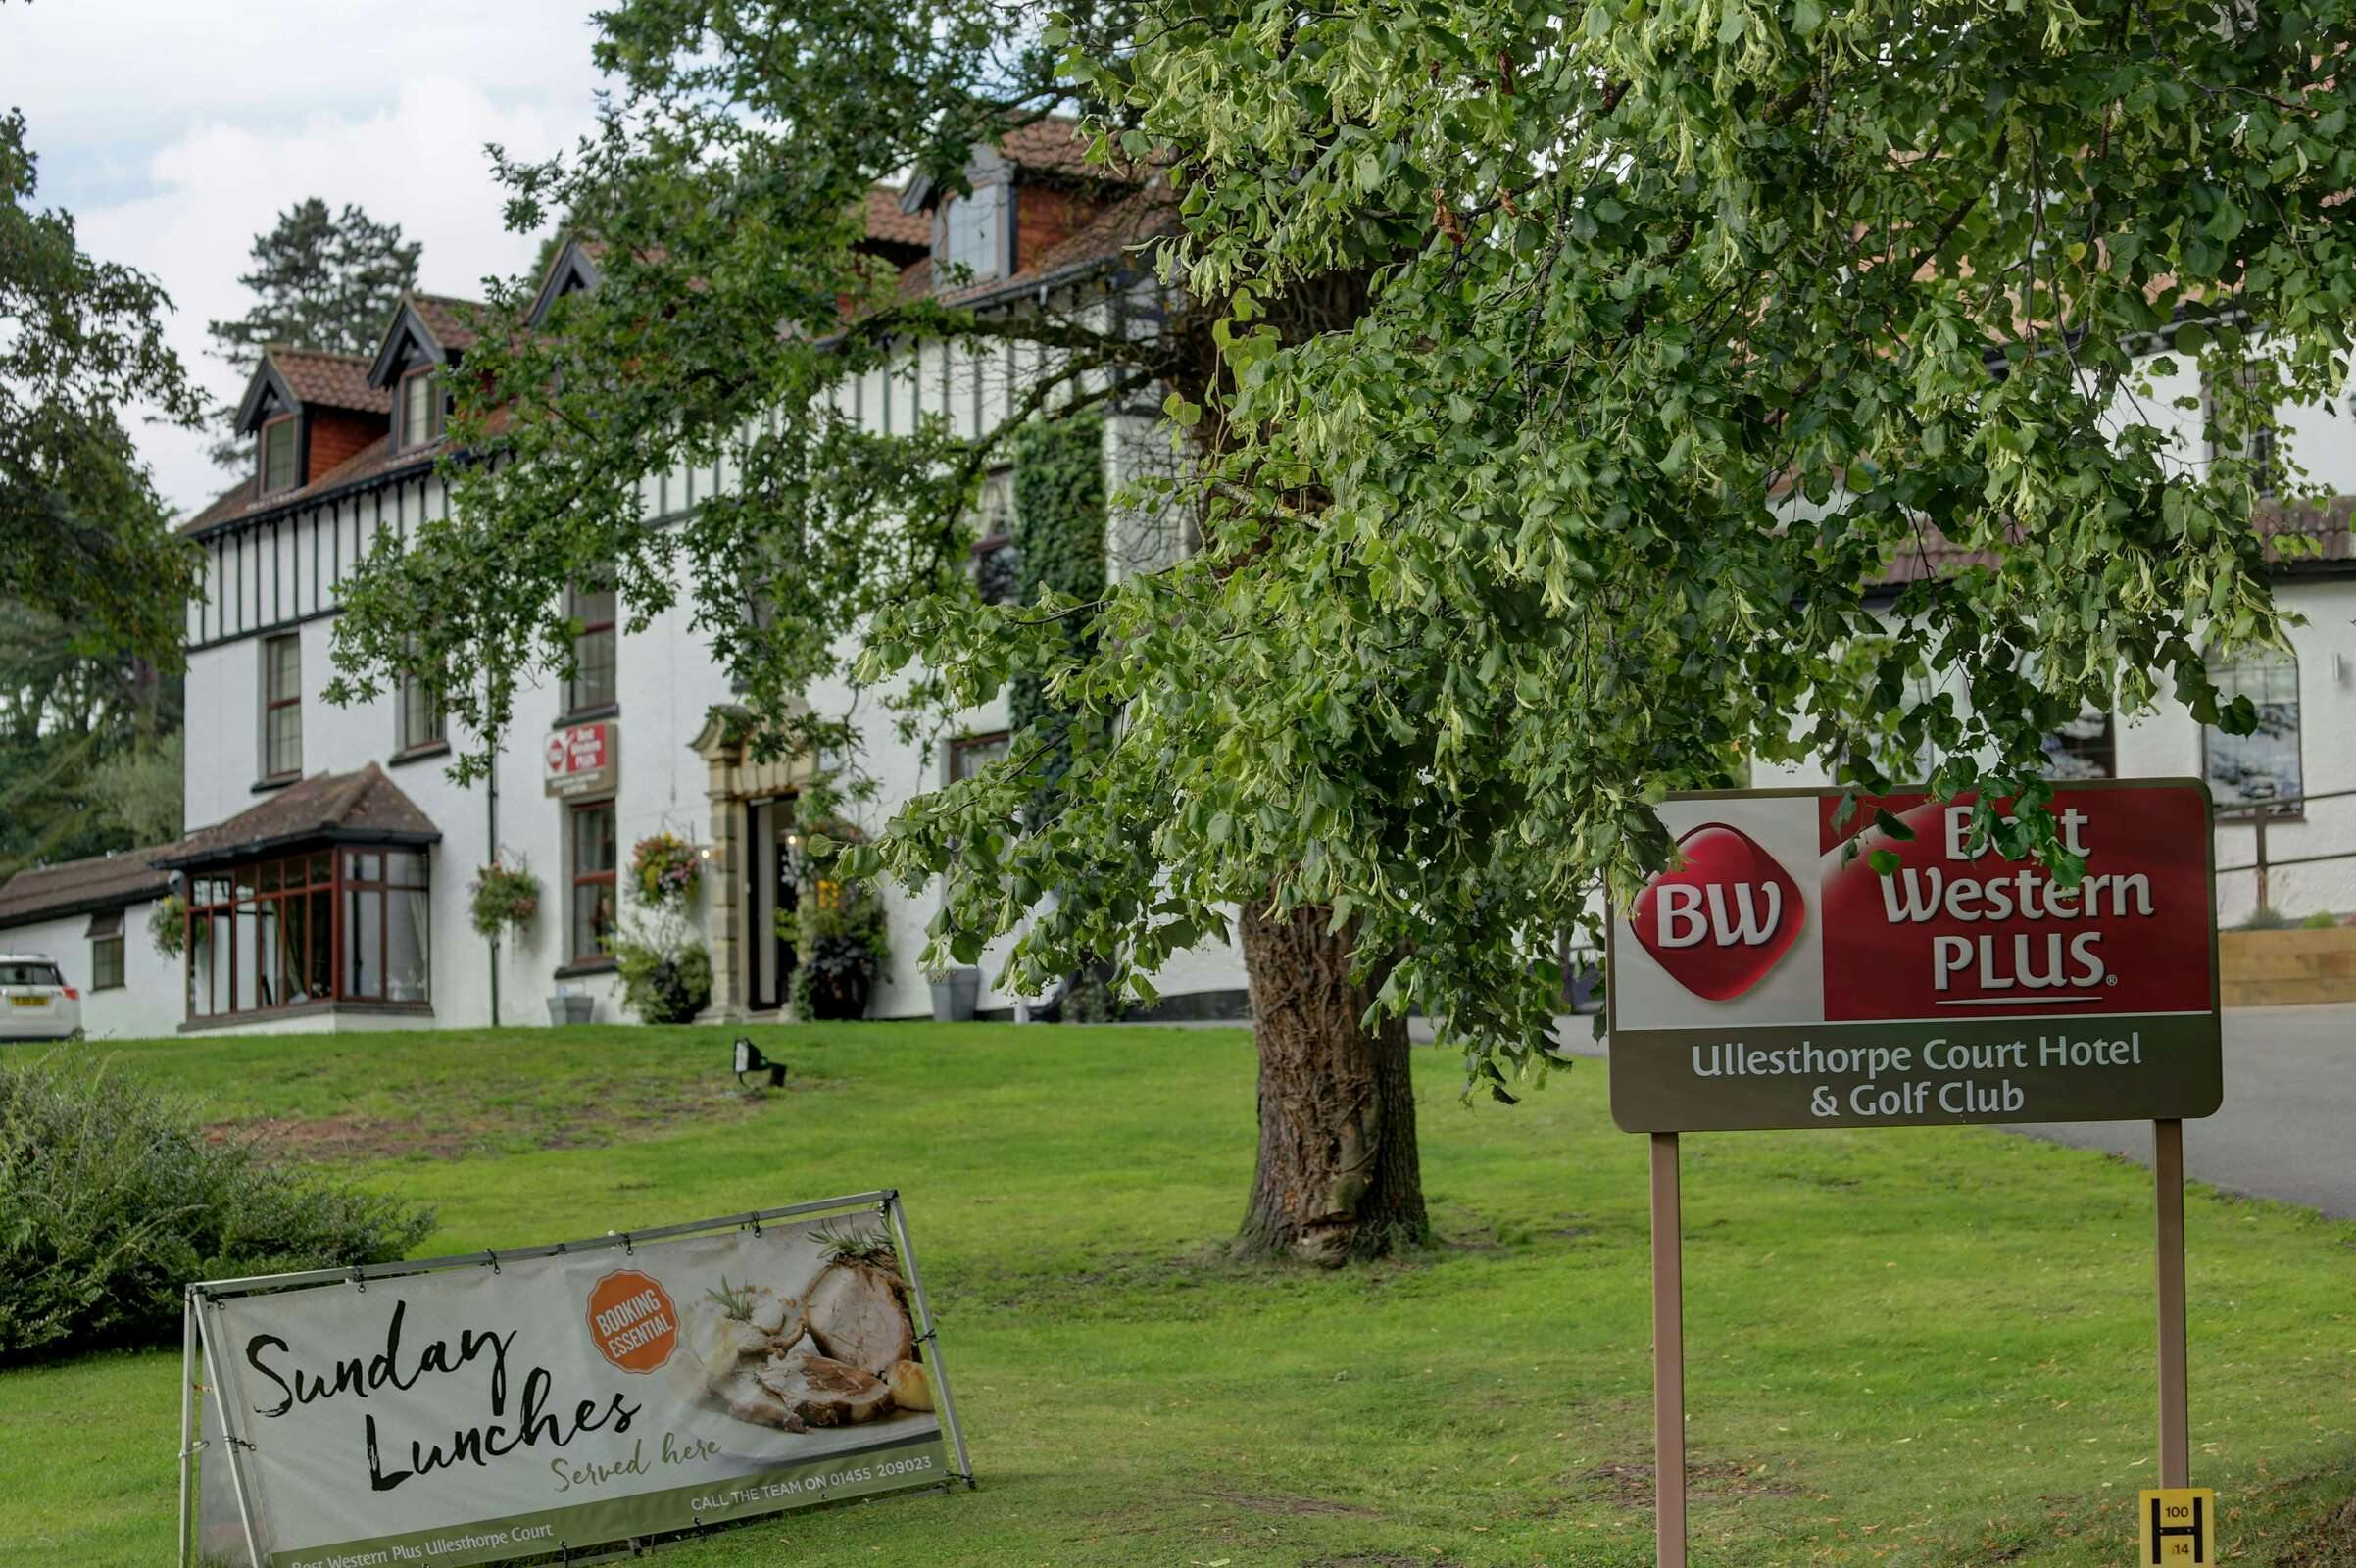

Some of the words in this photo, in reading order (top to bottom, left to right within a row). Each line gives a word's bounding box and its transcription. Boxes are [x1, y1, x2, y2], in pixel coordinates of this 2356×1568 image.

[1944, 806, 2091, 860] Bt
[1656, 880, 1782, 948] BW
[1879, 866, 2155, 923] Western
[1693, 1041, 1911, 1080] Ullesthorpe
[1923, 1038, 2028, 1071] Court
[2039, 1031, 2141, 1067] Hotel
[1810, 1085, 1841, 1117] &
[1849, 1081, 1931, 1116] Golf
[1939, 1079, 2025, 1114] Club
[595, 1288, 662, 1337] BOOKING
[607, 1312, 673, 1358] ESSENTIAL
[246, 1299, 517, 1418] Sunday
[366, 1367, 642, 1491] Lunches
[550, 1438, 651, 1493] Served
[662, 1432, 721, 1466] here
[690, 1494, 729, 1511] CALL
[731, 1488, 761, 1504] THE
[763, 1481, 802, 1498] TEAM
[805, 1476, 827, 1491] ON
[830, 1467, 872, 1487] 01455
[877, 1455, 932, 1477] 209023
[2151, 1497, 2203, 1564] H
[2165, 1506, 2189, 1518] 100
[326, 1551, 388, 1568] Western
[391, 1544, 422, 1561] Plus
[425, 1532, 509, 1556] Ullesthorpe
[511, 1523, 554, 1543] Court
